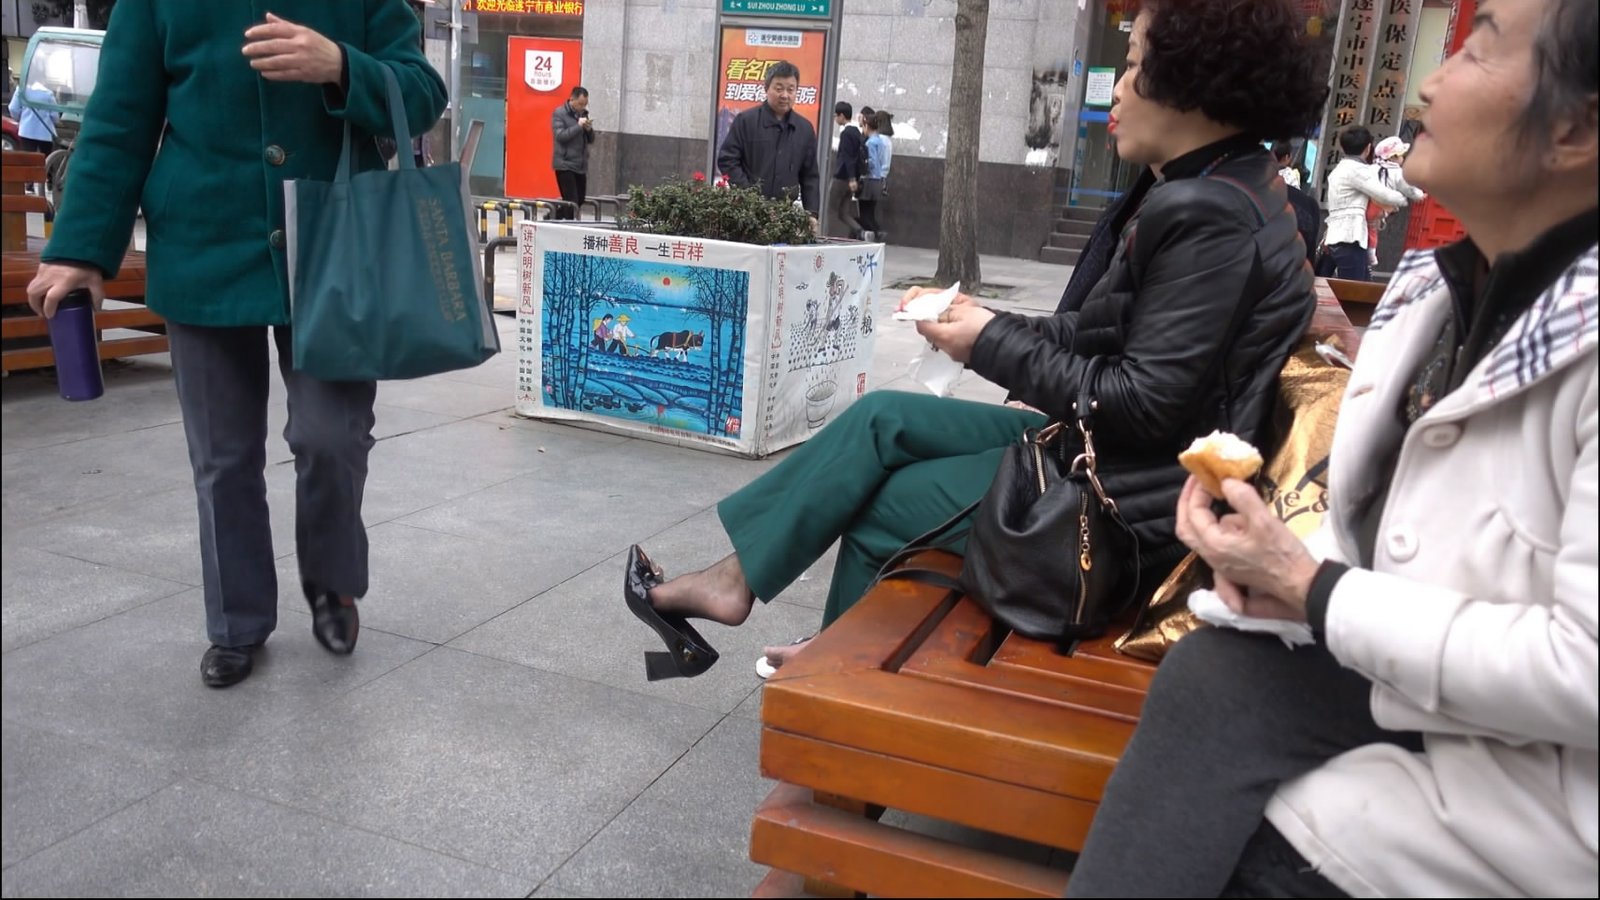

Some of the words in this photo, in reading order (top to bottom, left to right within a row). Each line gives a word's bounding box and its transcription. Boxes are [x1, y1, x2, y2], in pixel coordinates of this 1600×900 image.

[477, 0, 583, 15] 欢迎光临遂宁市商业银行
[775, 4, 796, 12] ZHONG
[534, 55, 553, 71] 24
[1370, 0, 1411, 138] 医保定点医
[583, 234, 640, 255] 播种善良
[645, 241, 704, 262] 一生吉祥
[522, 229, 534, 308] 讲文明树新风
